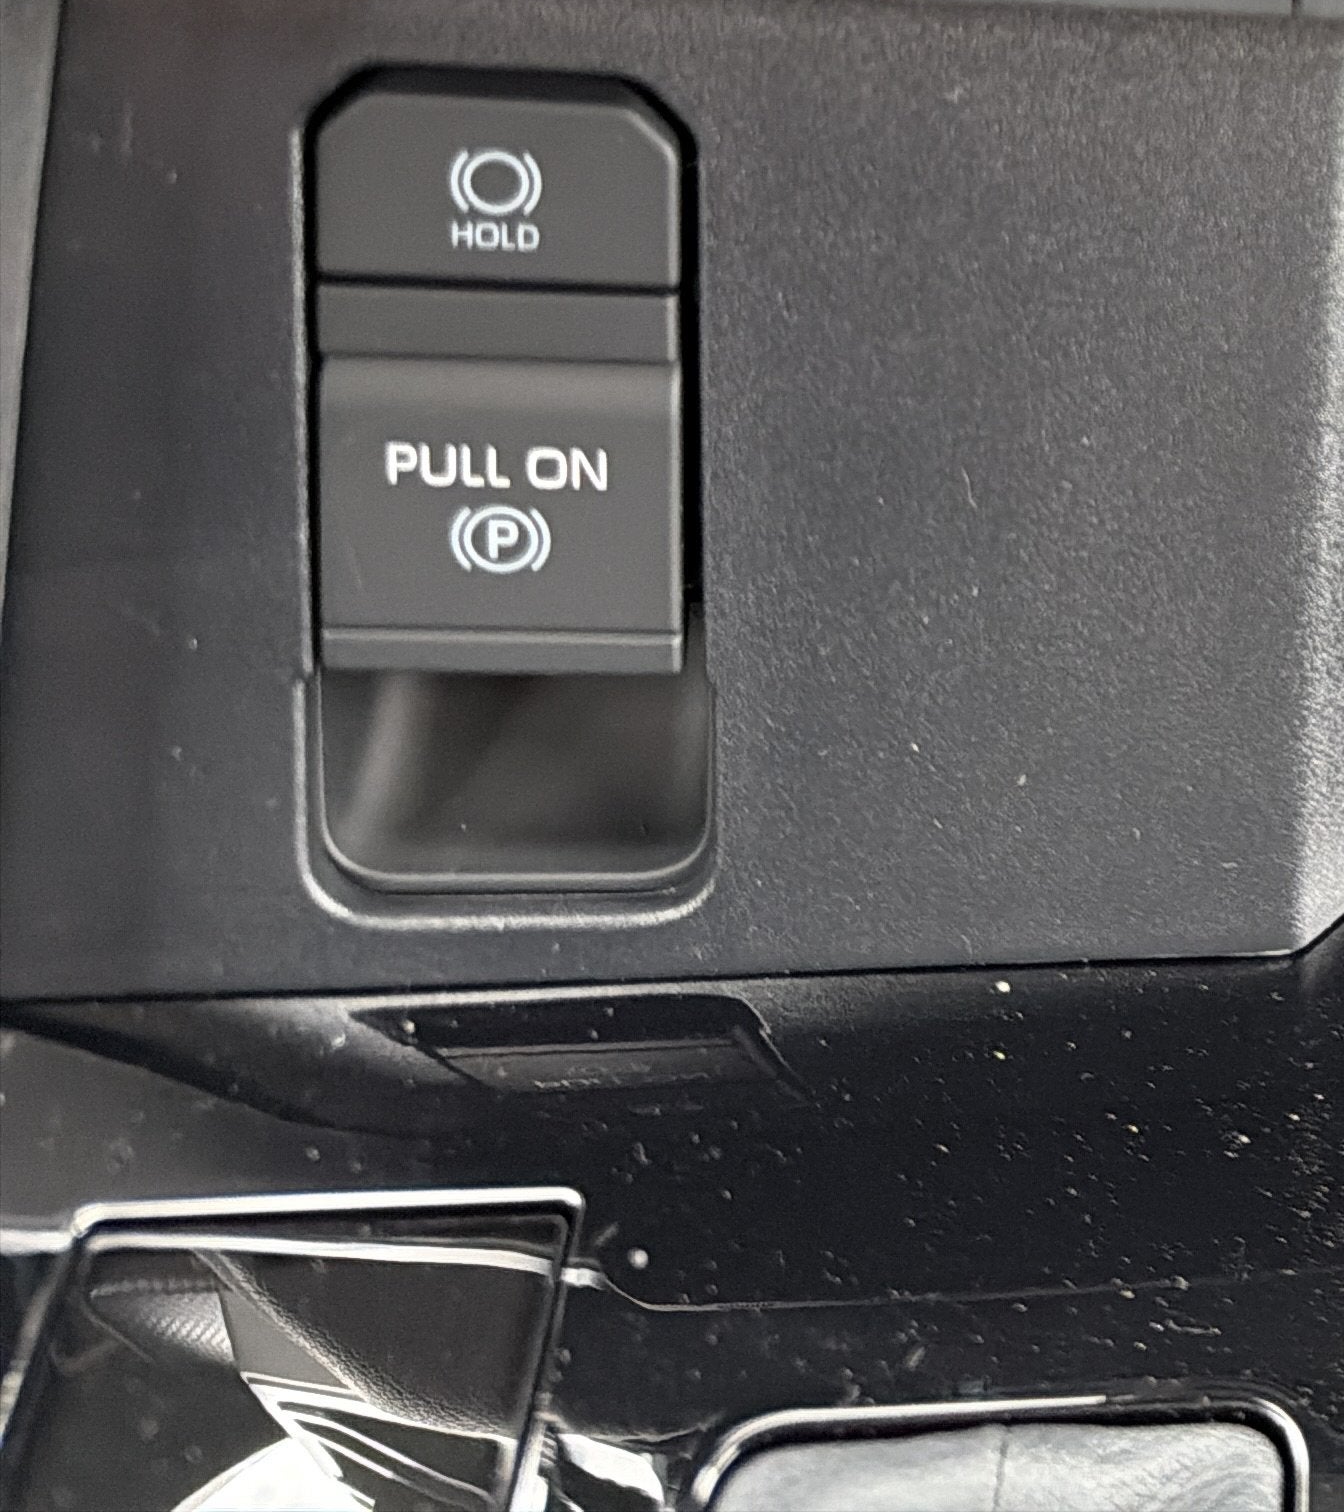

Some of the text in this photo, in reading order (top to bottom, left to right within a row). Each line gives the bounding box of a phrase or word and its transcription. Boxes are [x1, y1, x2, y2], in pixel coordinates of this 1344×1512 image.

[450, 220, 540, 252] HOLD
[385, 440, 608, 491] PULL ON
